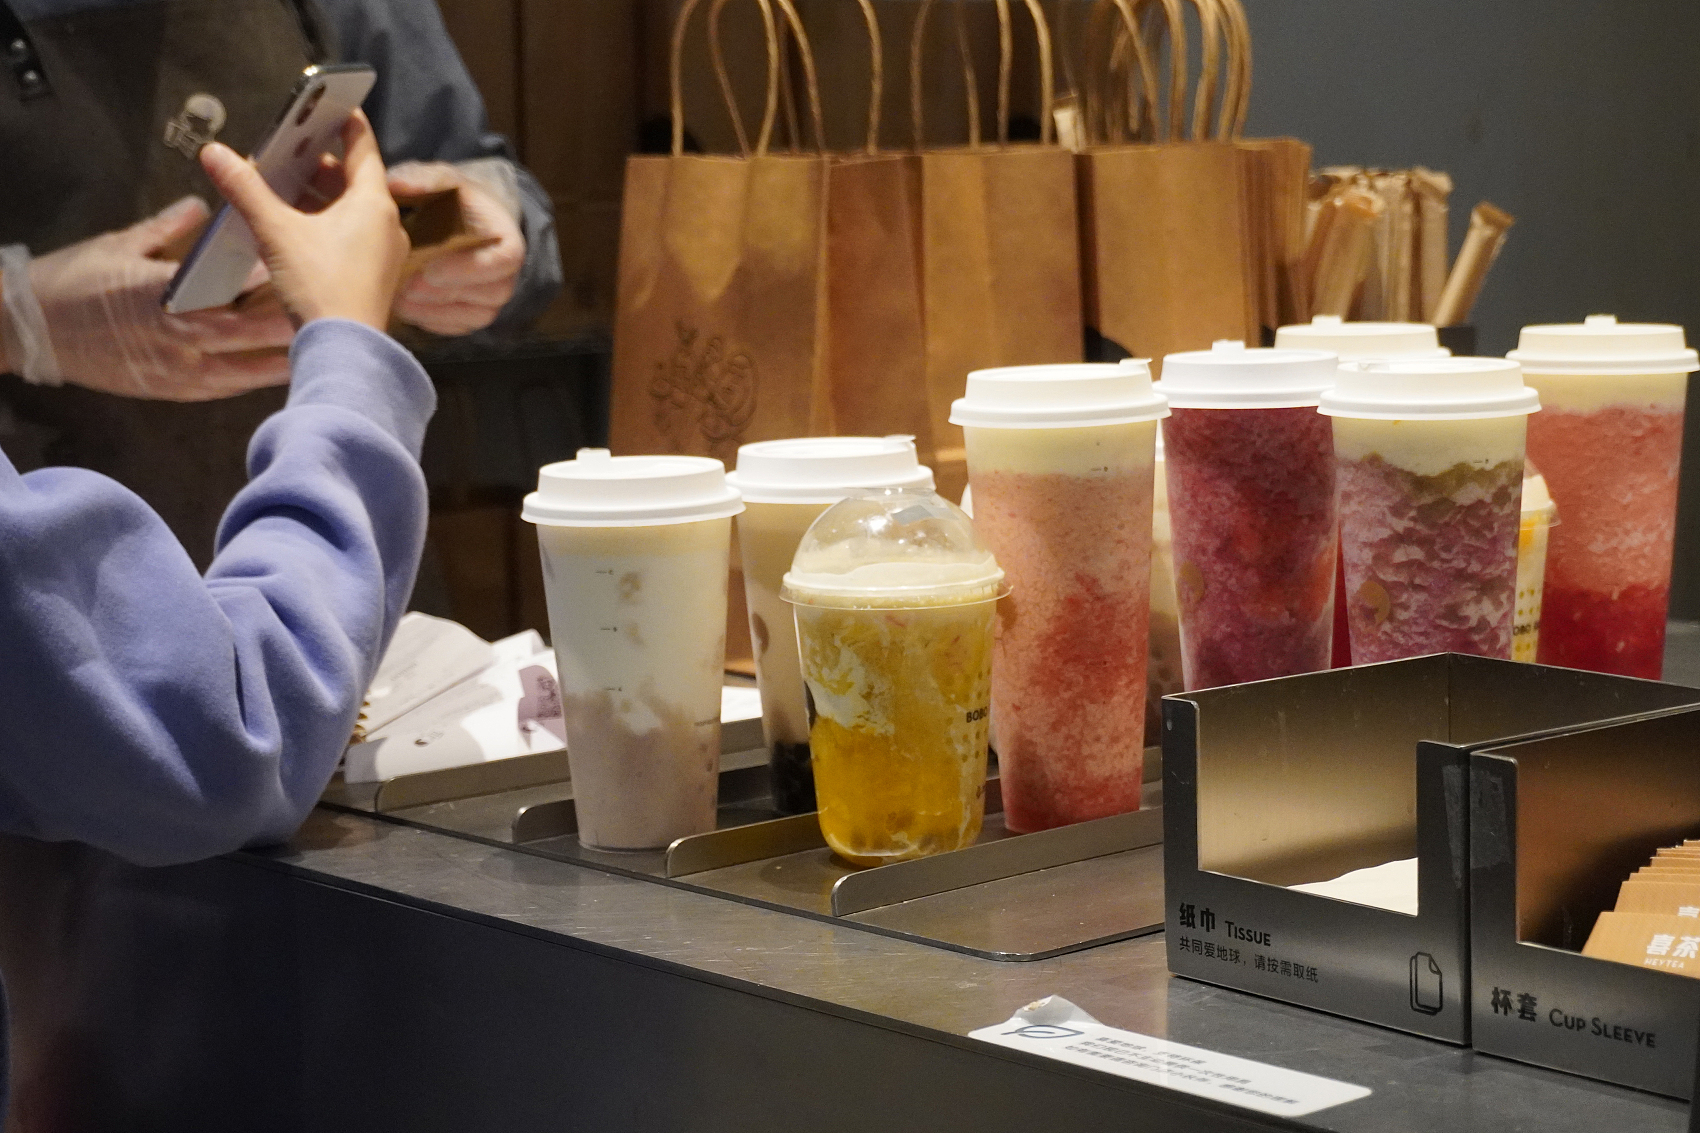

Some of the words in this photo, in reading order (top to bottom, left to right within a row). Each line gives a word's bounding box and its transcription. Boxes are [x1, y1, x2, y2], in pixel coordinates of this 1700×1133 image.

[1179, 902, 1215, 932] 纸巾
[1646, 934, 1700, 959] 喜茶
[1644, 958, 1684, 969] HEYTEA
[1491, 987, 1537, 1022] 杯套
